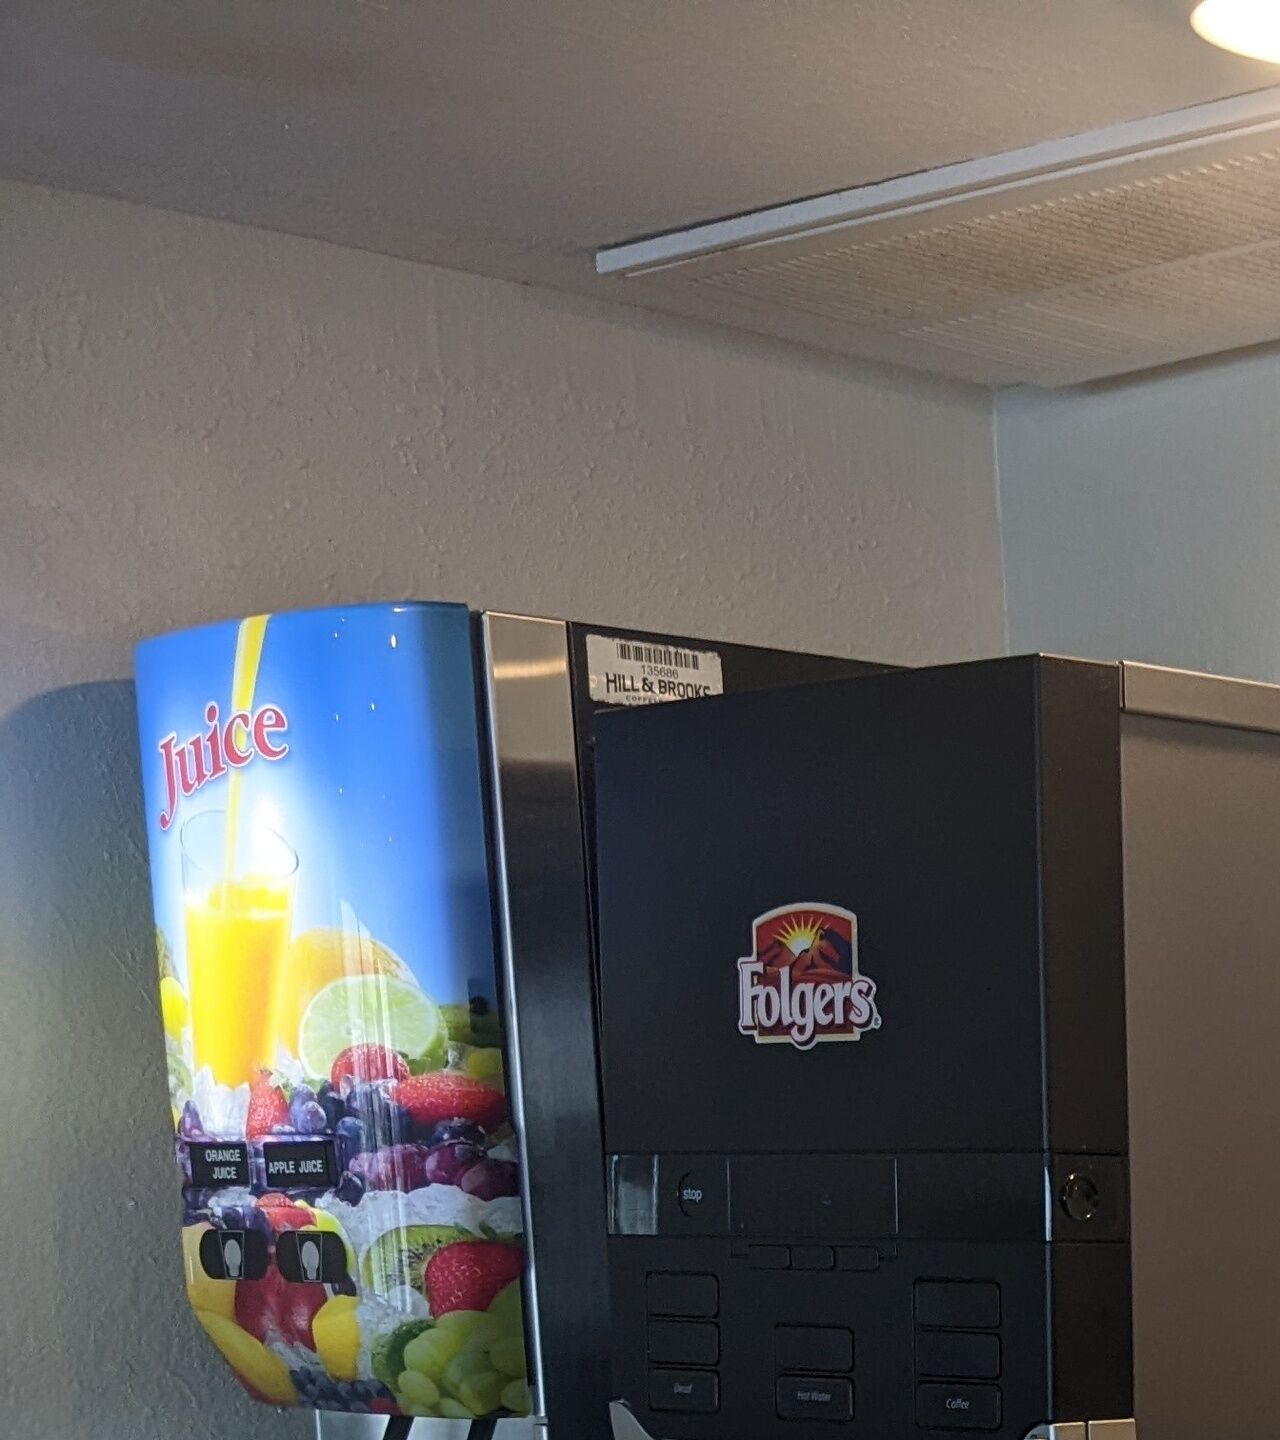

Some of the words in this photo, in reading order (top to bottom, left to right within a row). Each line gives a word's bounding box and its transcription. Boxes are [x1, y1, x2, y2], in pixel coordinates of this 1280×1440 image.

[641, 665, 679, 680] 135686
[605, 672, 639, 693] HILL
[642, 676, 656, 694] &
[160, 704, 288, 829] Juice
[739, 961, 873, 1043] Folgers
[205, 1149, 242, 1162] ORANGE
[212, 1167, 238, 1179] JUICE
[268, 1161, 296, 1174] APPLE
[298, 1160, 324, 1173] JUICE
[683, 1188, 703, 1203] stop
